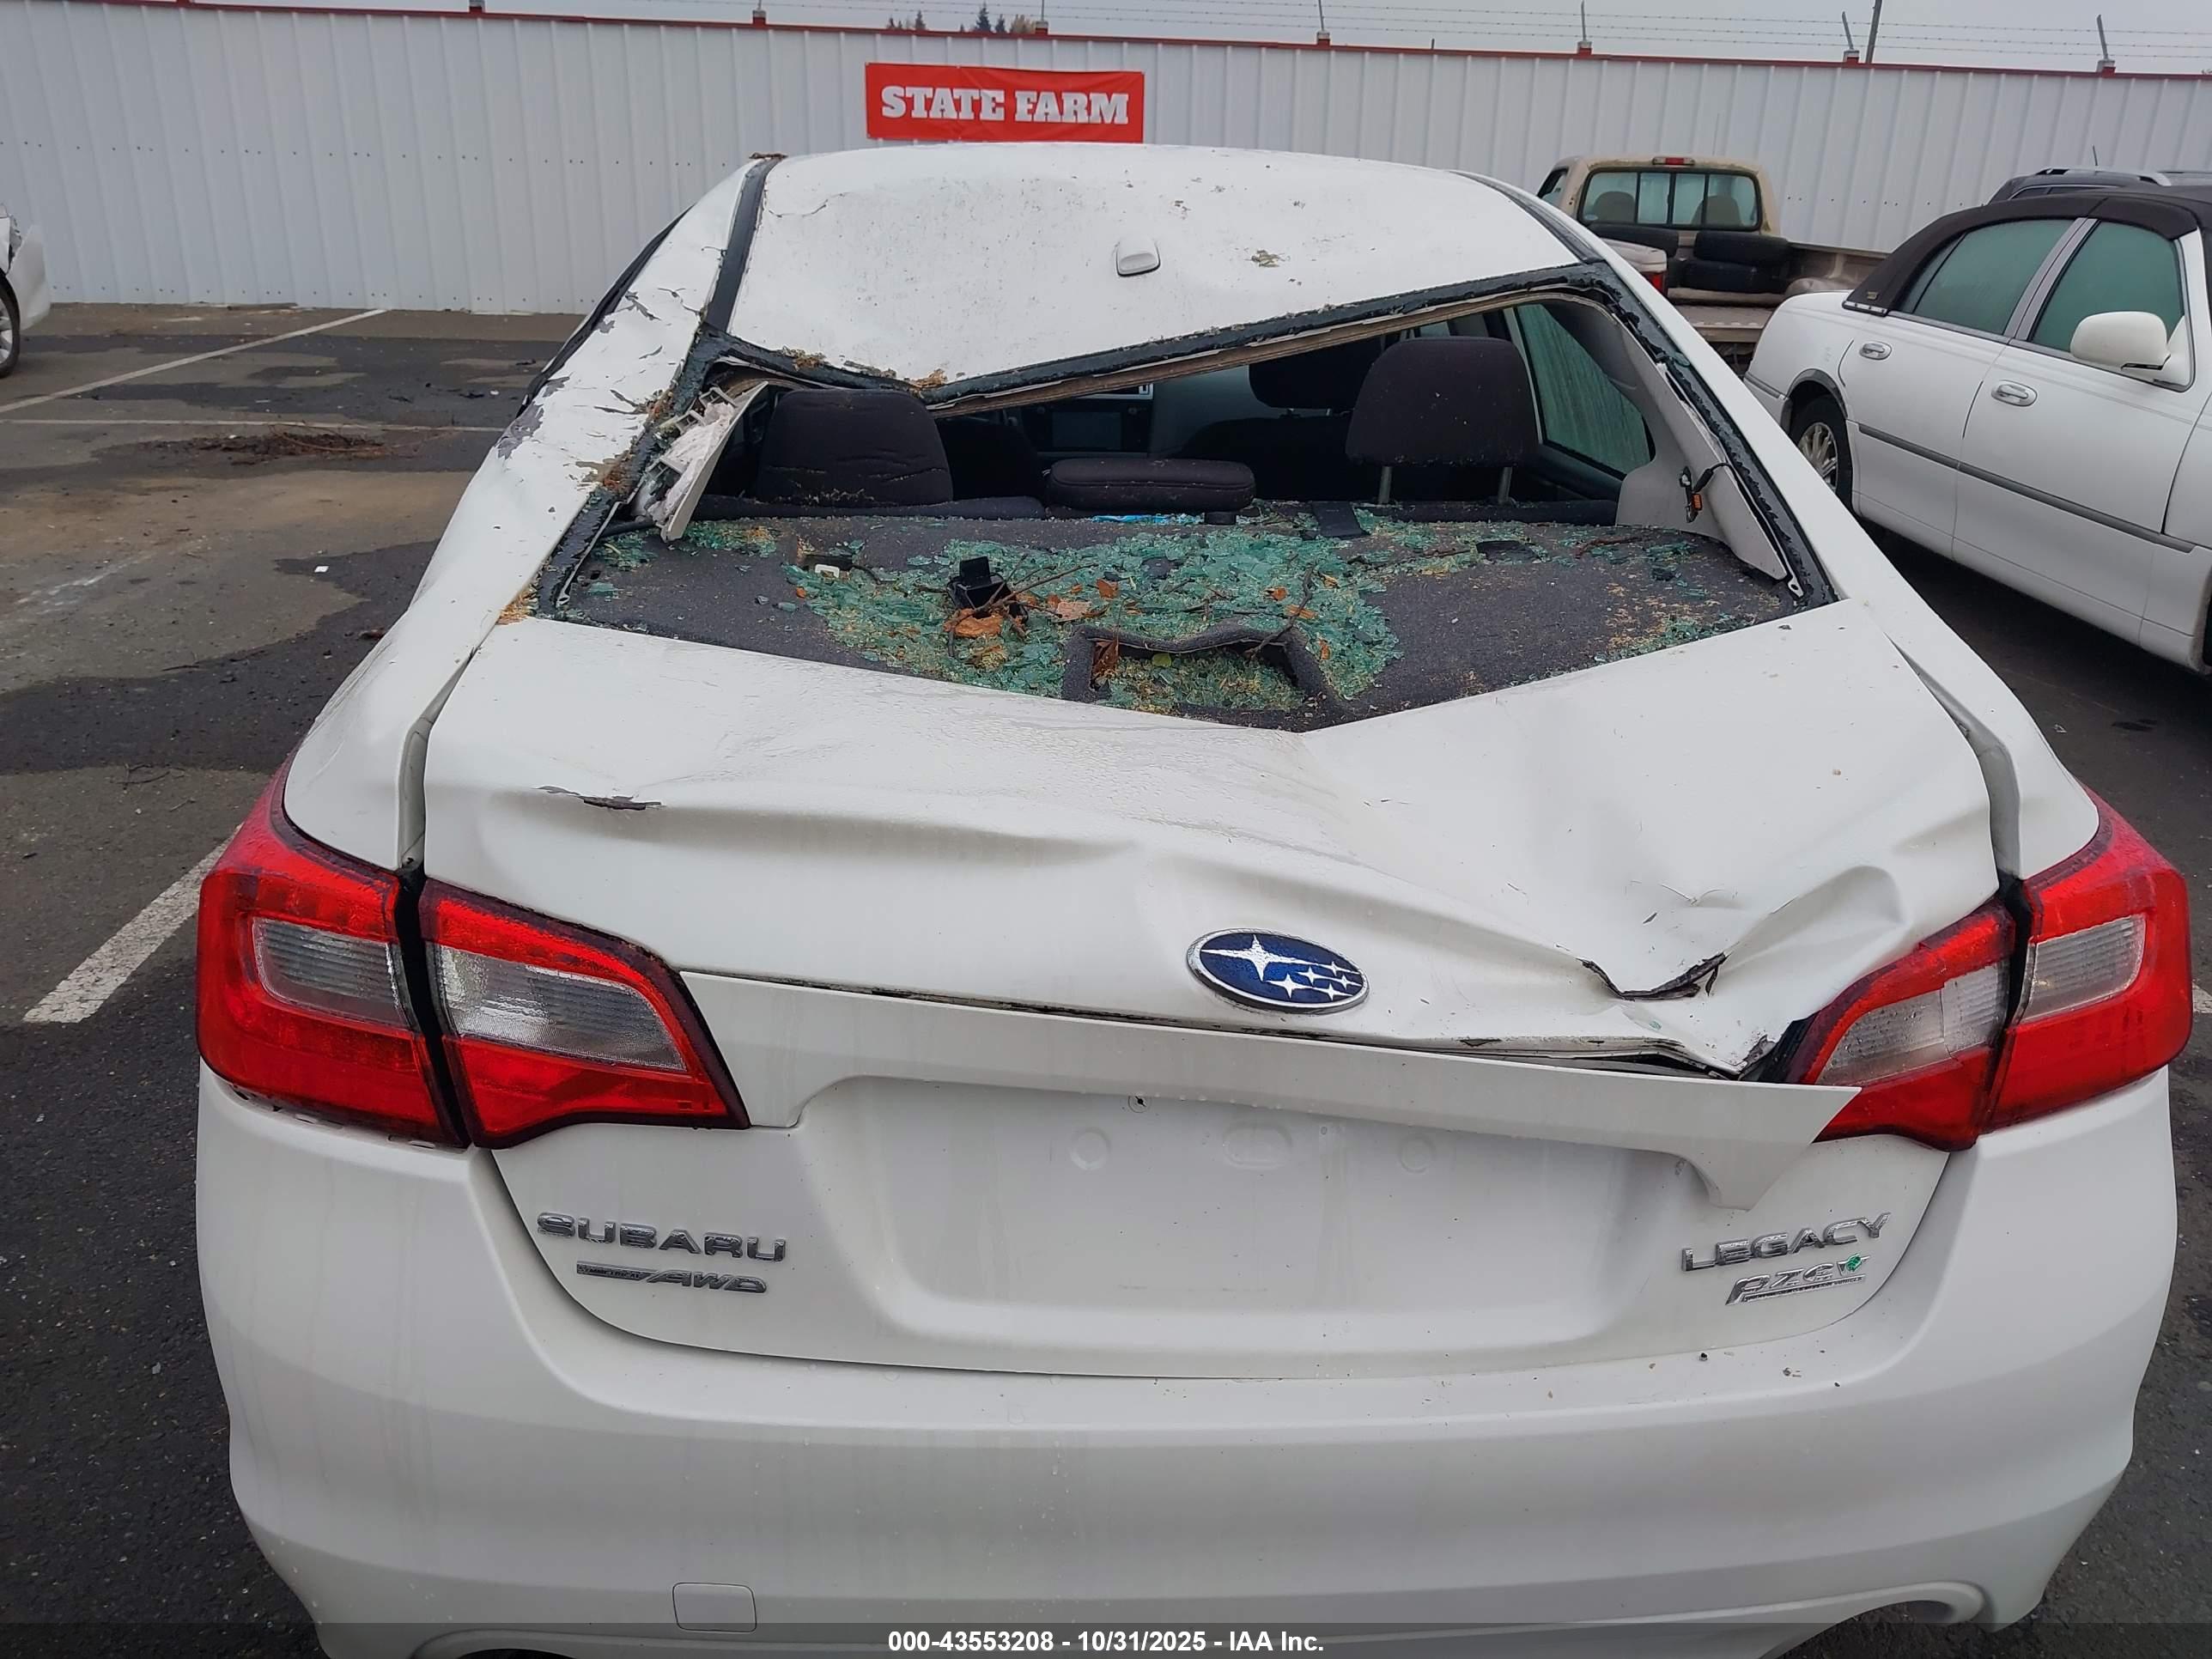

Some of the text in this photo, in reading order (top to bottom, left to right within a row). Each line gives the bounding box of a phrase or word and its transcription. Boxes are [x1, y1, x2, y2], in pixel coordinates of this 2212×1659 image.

[881, 85, 1129, 125] STATE FARM
[536, 1212, 787, 1262] SUBARU
[1681, 1212, 1892, 1272] LEGACY
[646, 1269, 767, 1293] AWD
